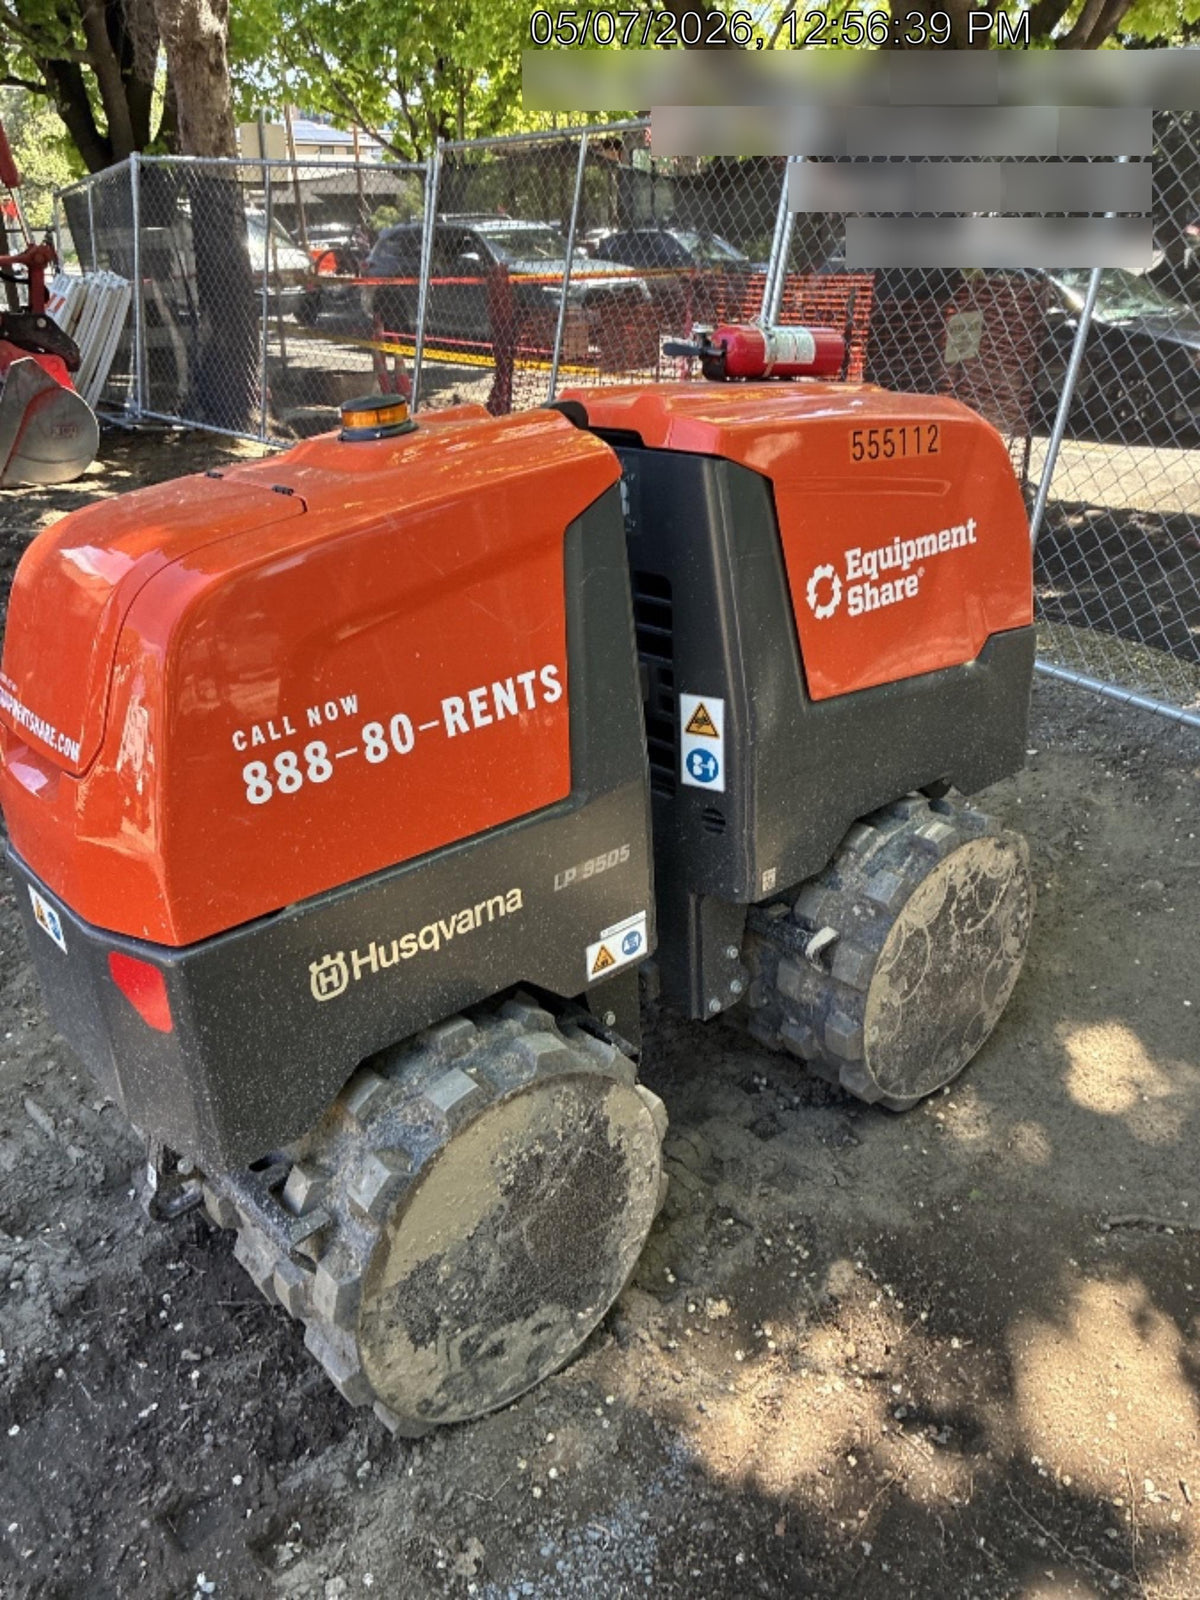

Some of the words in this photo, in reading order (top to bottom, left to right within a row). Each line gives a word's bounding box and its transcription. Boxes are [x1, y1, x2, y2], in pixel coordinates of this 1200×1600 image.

[852, 424, 939, 462] 555112
[844, 517, 978, 582] Equipment
[231, 715, 297, 751] CALL
[306, 694, 359, 728] NOW
[242, 664, 563, 805] 888-80-RENTS
[553, 865, 577, 892] LP
[582, 843, 631, 880] 9505
[351, 887, 524, 981] Husqvarna
